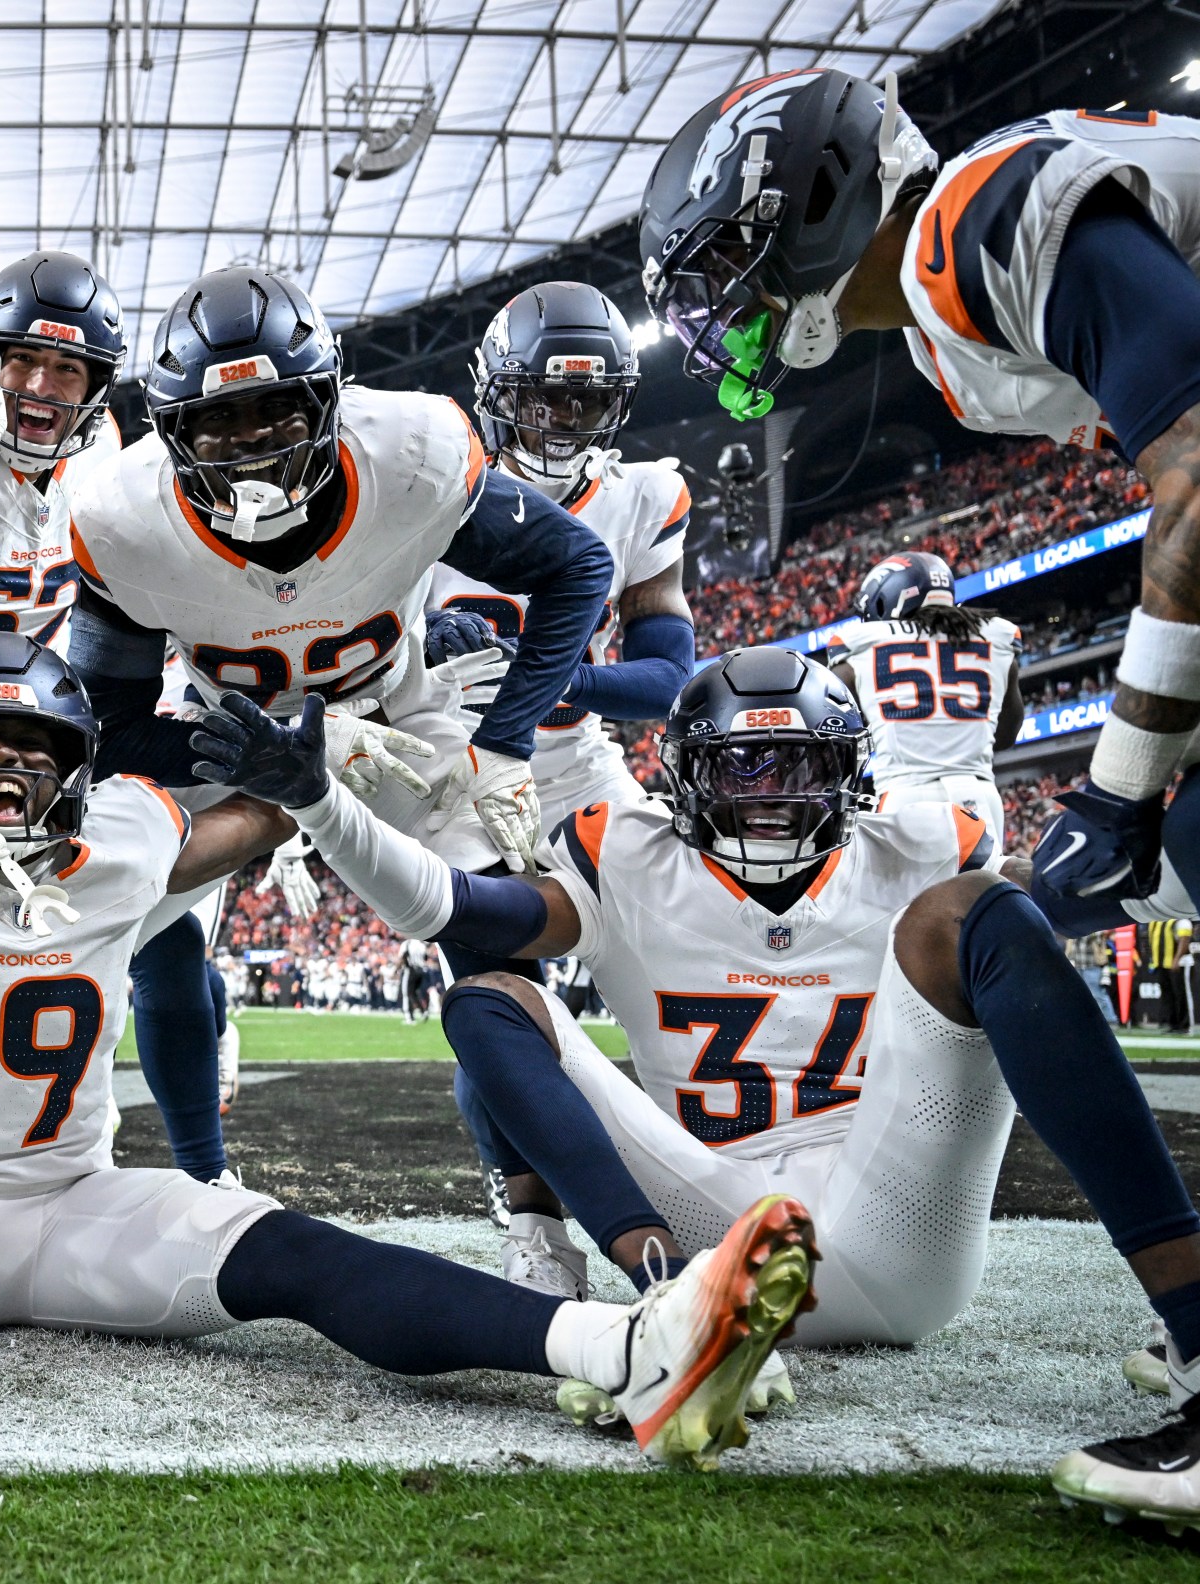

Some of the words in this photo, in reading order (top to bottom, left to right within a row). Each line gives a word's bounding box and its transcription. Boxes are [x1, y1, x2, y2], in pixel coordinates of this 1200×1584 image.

[39, 322, 77, 342] 5280
[218, 361, 258, 383] 5280
[565, 359, 592, 371] 5280
[10, 546, 63, 561] BROCOS
[929, 570, 950, 588] 55
[278, 589, 297, 602] NFL
[251, 619, 344, 641] BRONCOS
[873, 640, 992, 723] 55
[745, 709, 792, 727] 5280
[687, 728, 712, 738] OAKLEY
[821, 725, 847, 733] OAKLEY
[769, 935, 791, 948] NFL
[726, 973, 831, 987] BRONCOS
